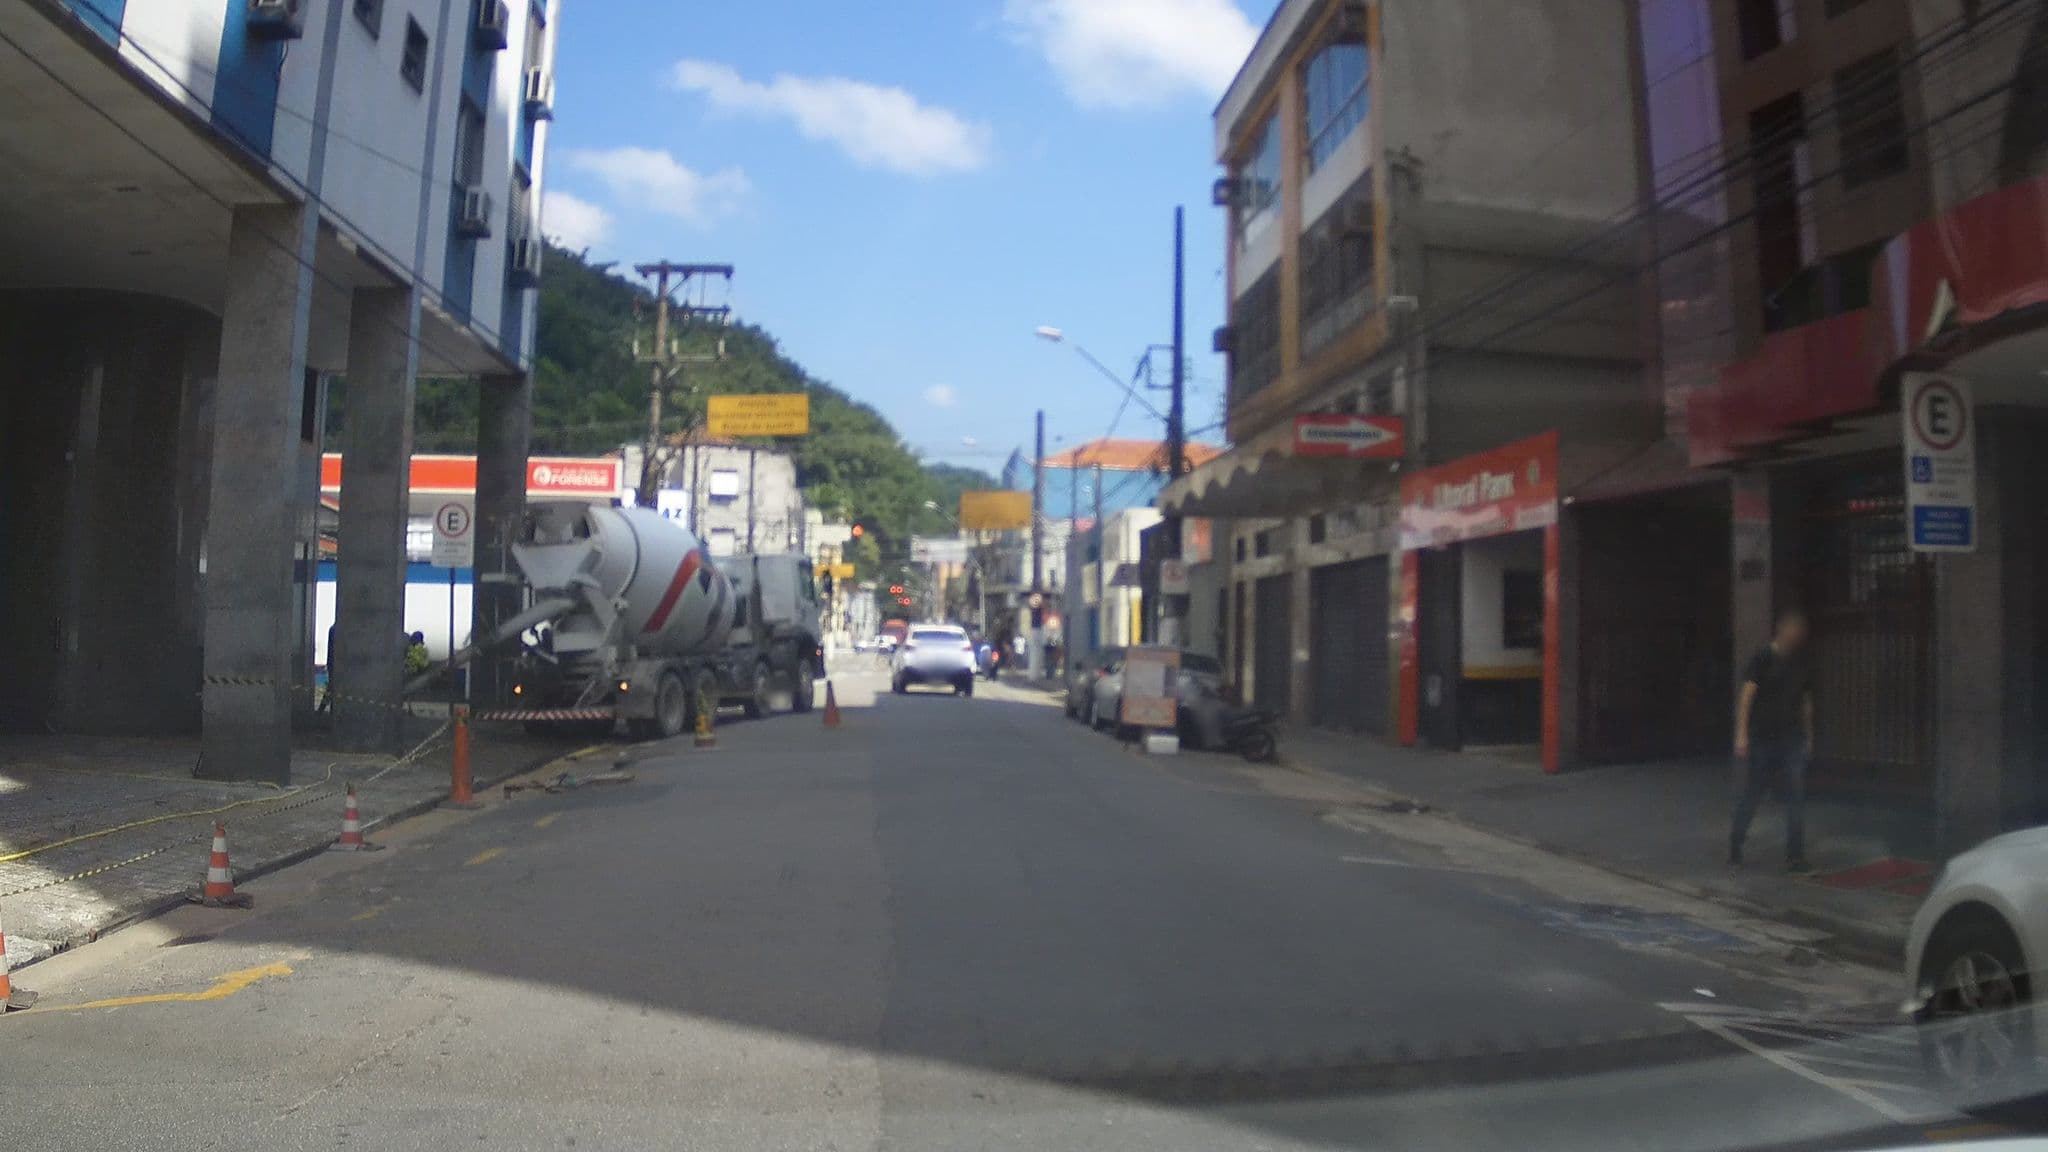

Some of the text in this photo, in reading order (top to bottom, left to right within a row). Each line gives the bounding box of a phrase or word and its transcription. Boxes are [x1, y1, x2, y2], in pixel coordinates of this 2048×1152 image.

[1929, 395, 1950, 435] E
[550, 473, 609, 487] FORENSE
[448, 512, 459, 531] E
